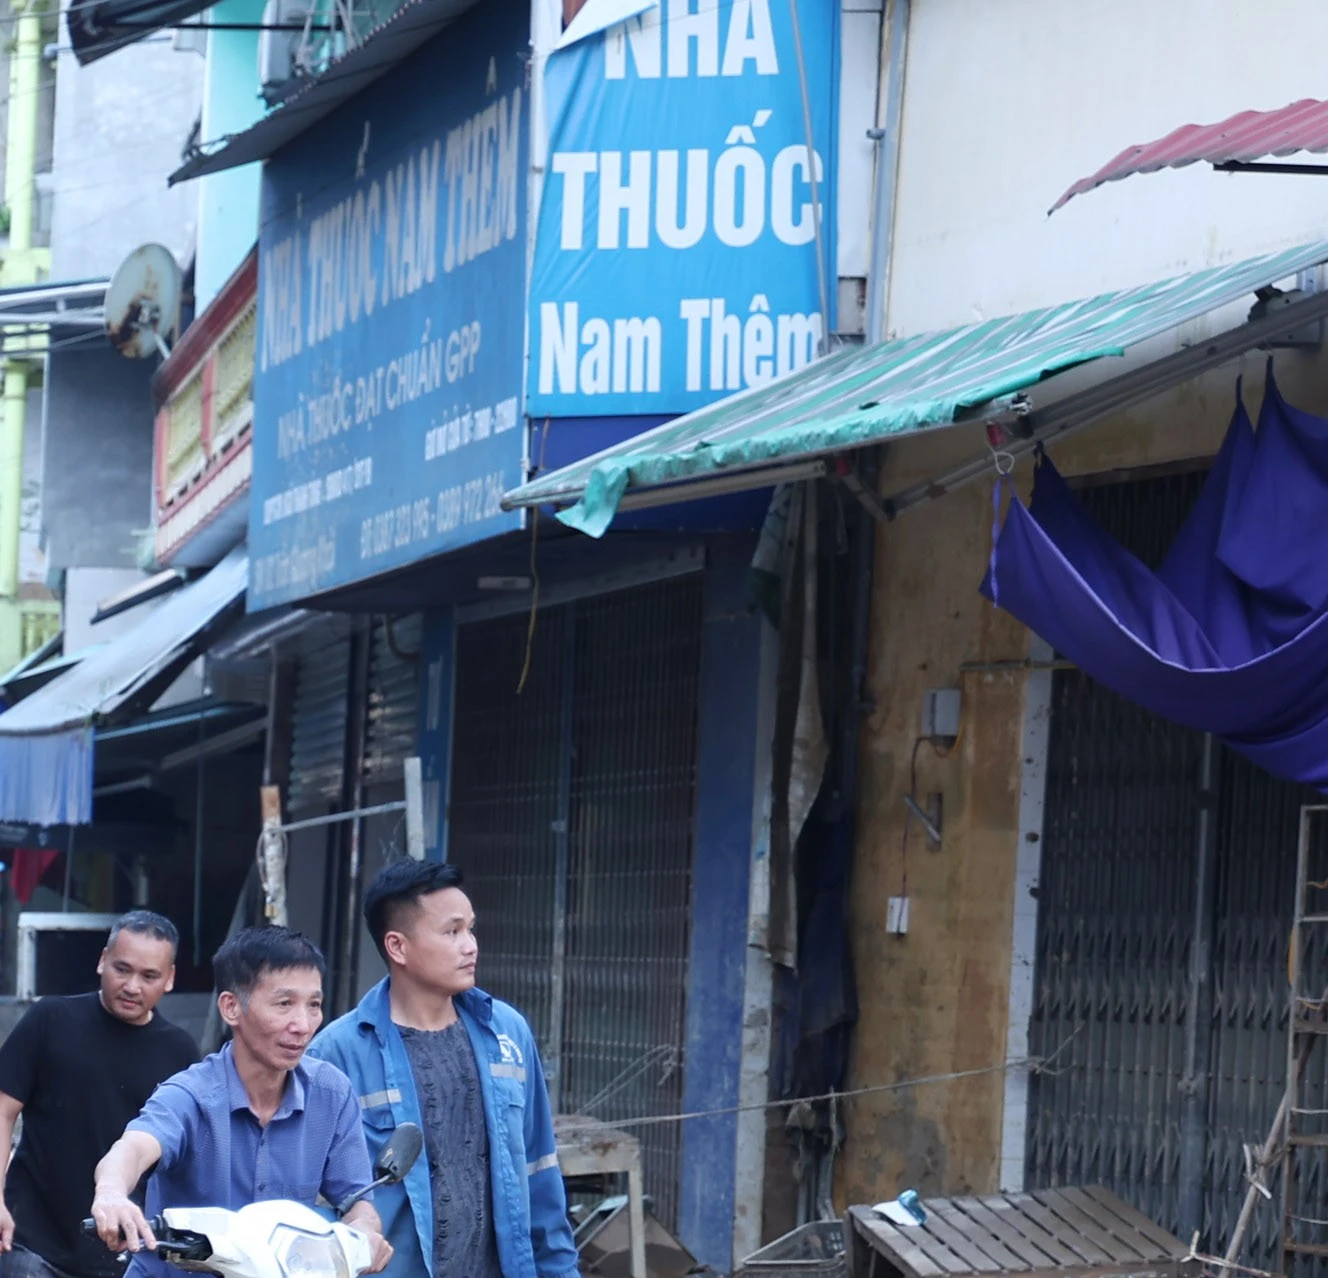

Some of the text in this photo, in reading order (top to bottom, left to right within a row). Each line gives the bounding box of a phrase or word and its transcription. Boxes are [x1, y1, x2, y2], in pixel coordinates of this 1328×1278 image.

[552, 108, 824, 251] THUỐC
[445, 319, 482, 385] GPP
[538, 293, 824, 396] Nam Thêm
